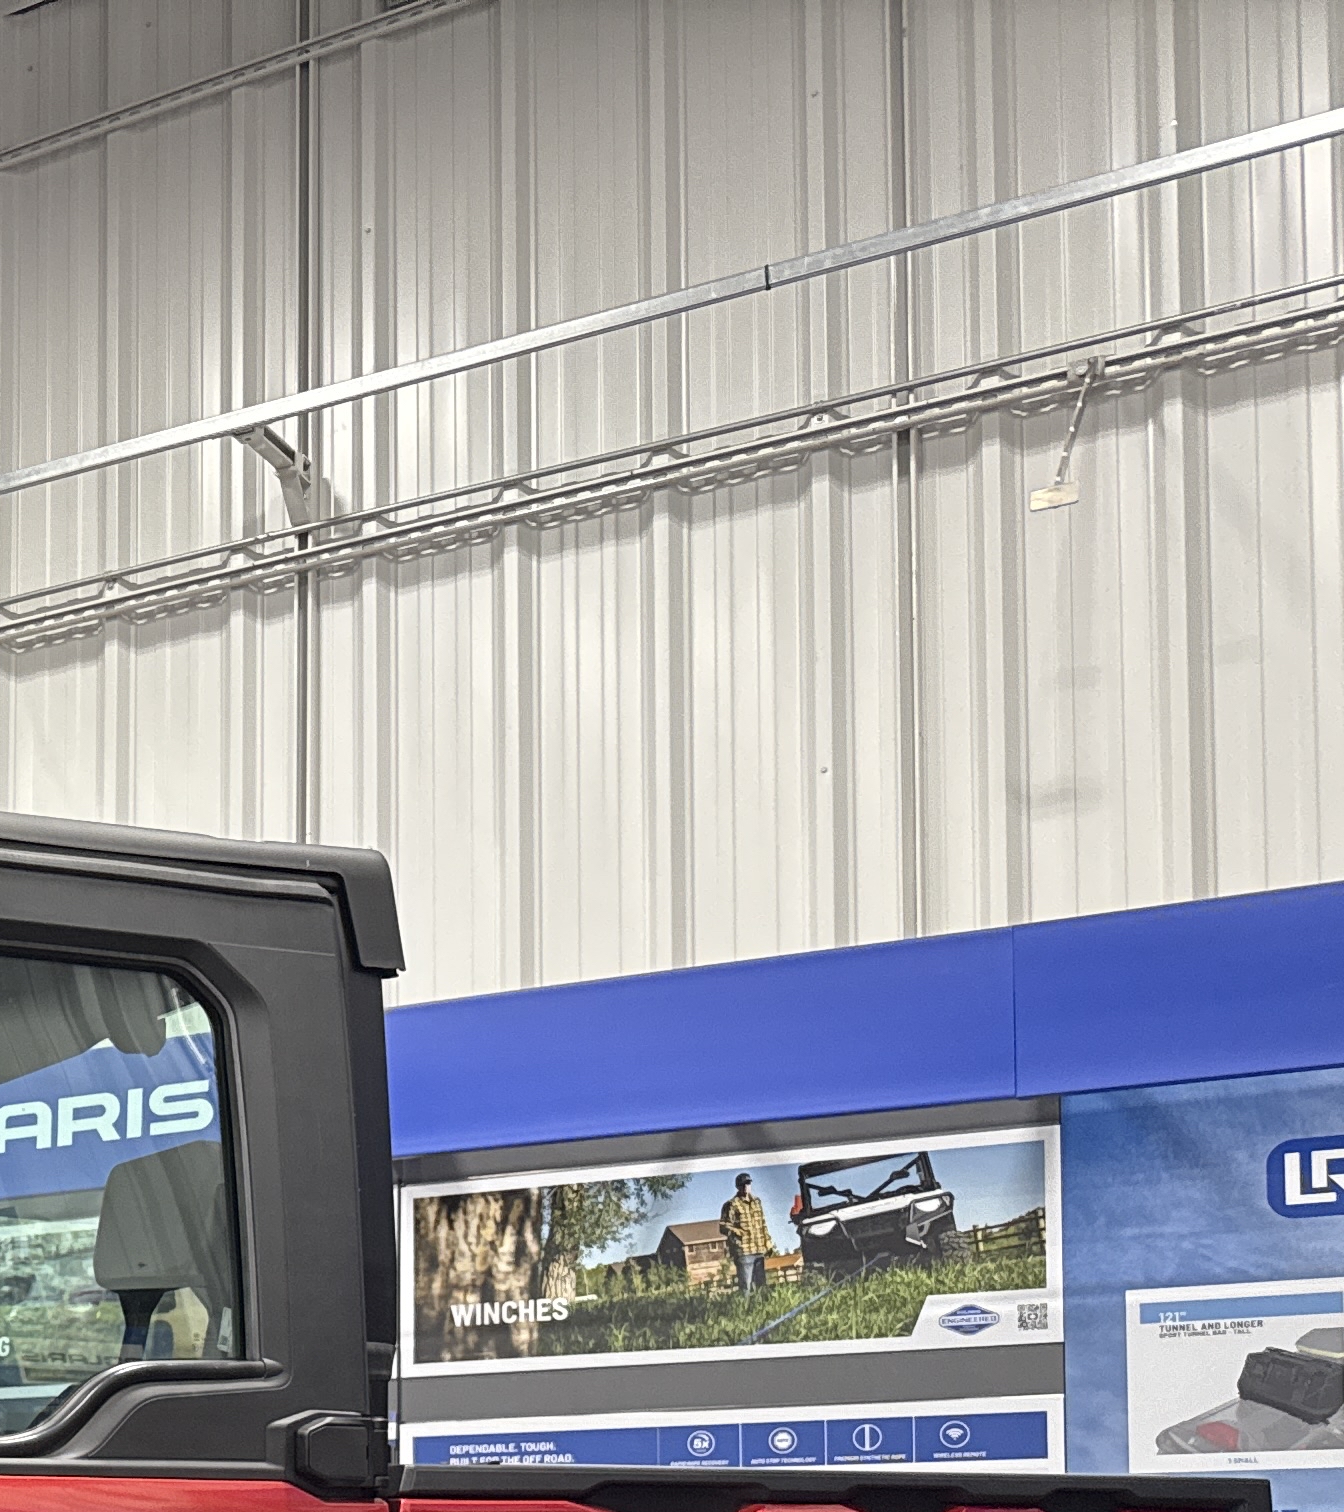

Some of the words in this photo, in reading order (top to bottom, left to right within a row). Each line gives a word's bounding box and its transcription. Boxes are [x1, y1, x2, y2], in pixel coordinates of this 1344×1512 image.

[451, 1297, 569, 1327] WINCHES
[1159, 1323, 1198, 1333] TUNNEL
[1201, 1322, 1221, 1330] AND
[1224, 1319, 1264, 1329] LONGER
[519, 1441, 557, 1452] TOUGH.
[522, 1454, 542, 1464] OFF
[543, 1452, 575, 1464] ROAD.
